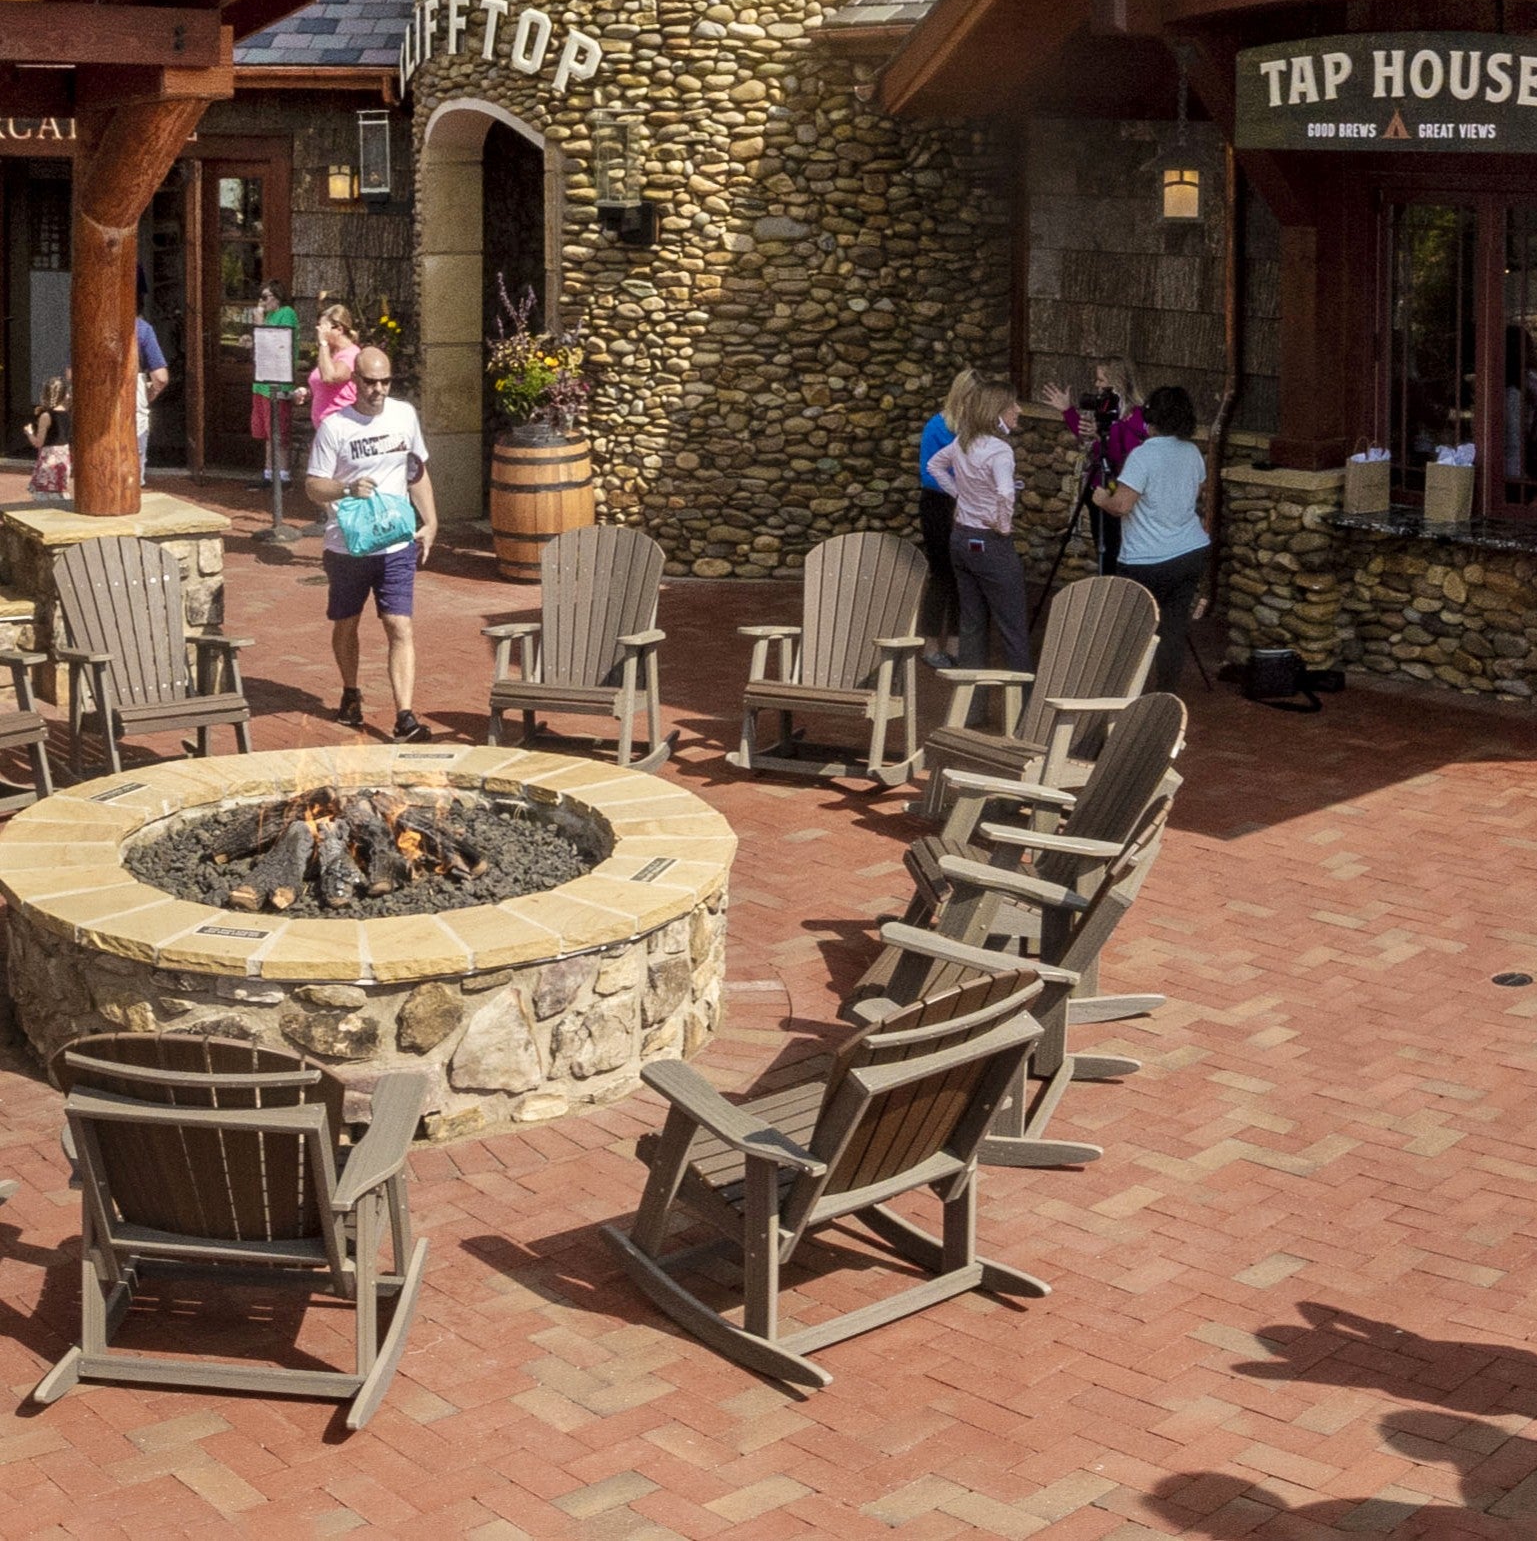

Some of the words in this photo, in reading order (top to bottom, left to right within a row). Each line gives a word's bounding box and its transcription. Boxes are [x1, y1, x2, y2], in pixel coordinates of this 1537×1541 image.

[1260, 52, 1352, 107] TAP
[1307, 123, 1334, 137] GOOD
[1339, 123, 1376, 137] BREWS
[1418, 123, 1454, 138] GREAT
[1459, 123, 1496, 138] VIEWS
